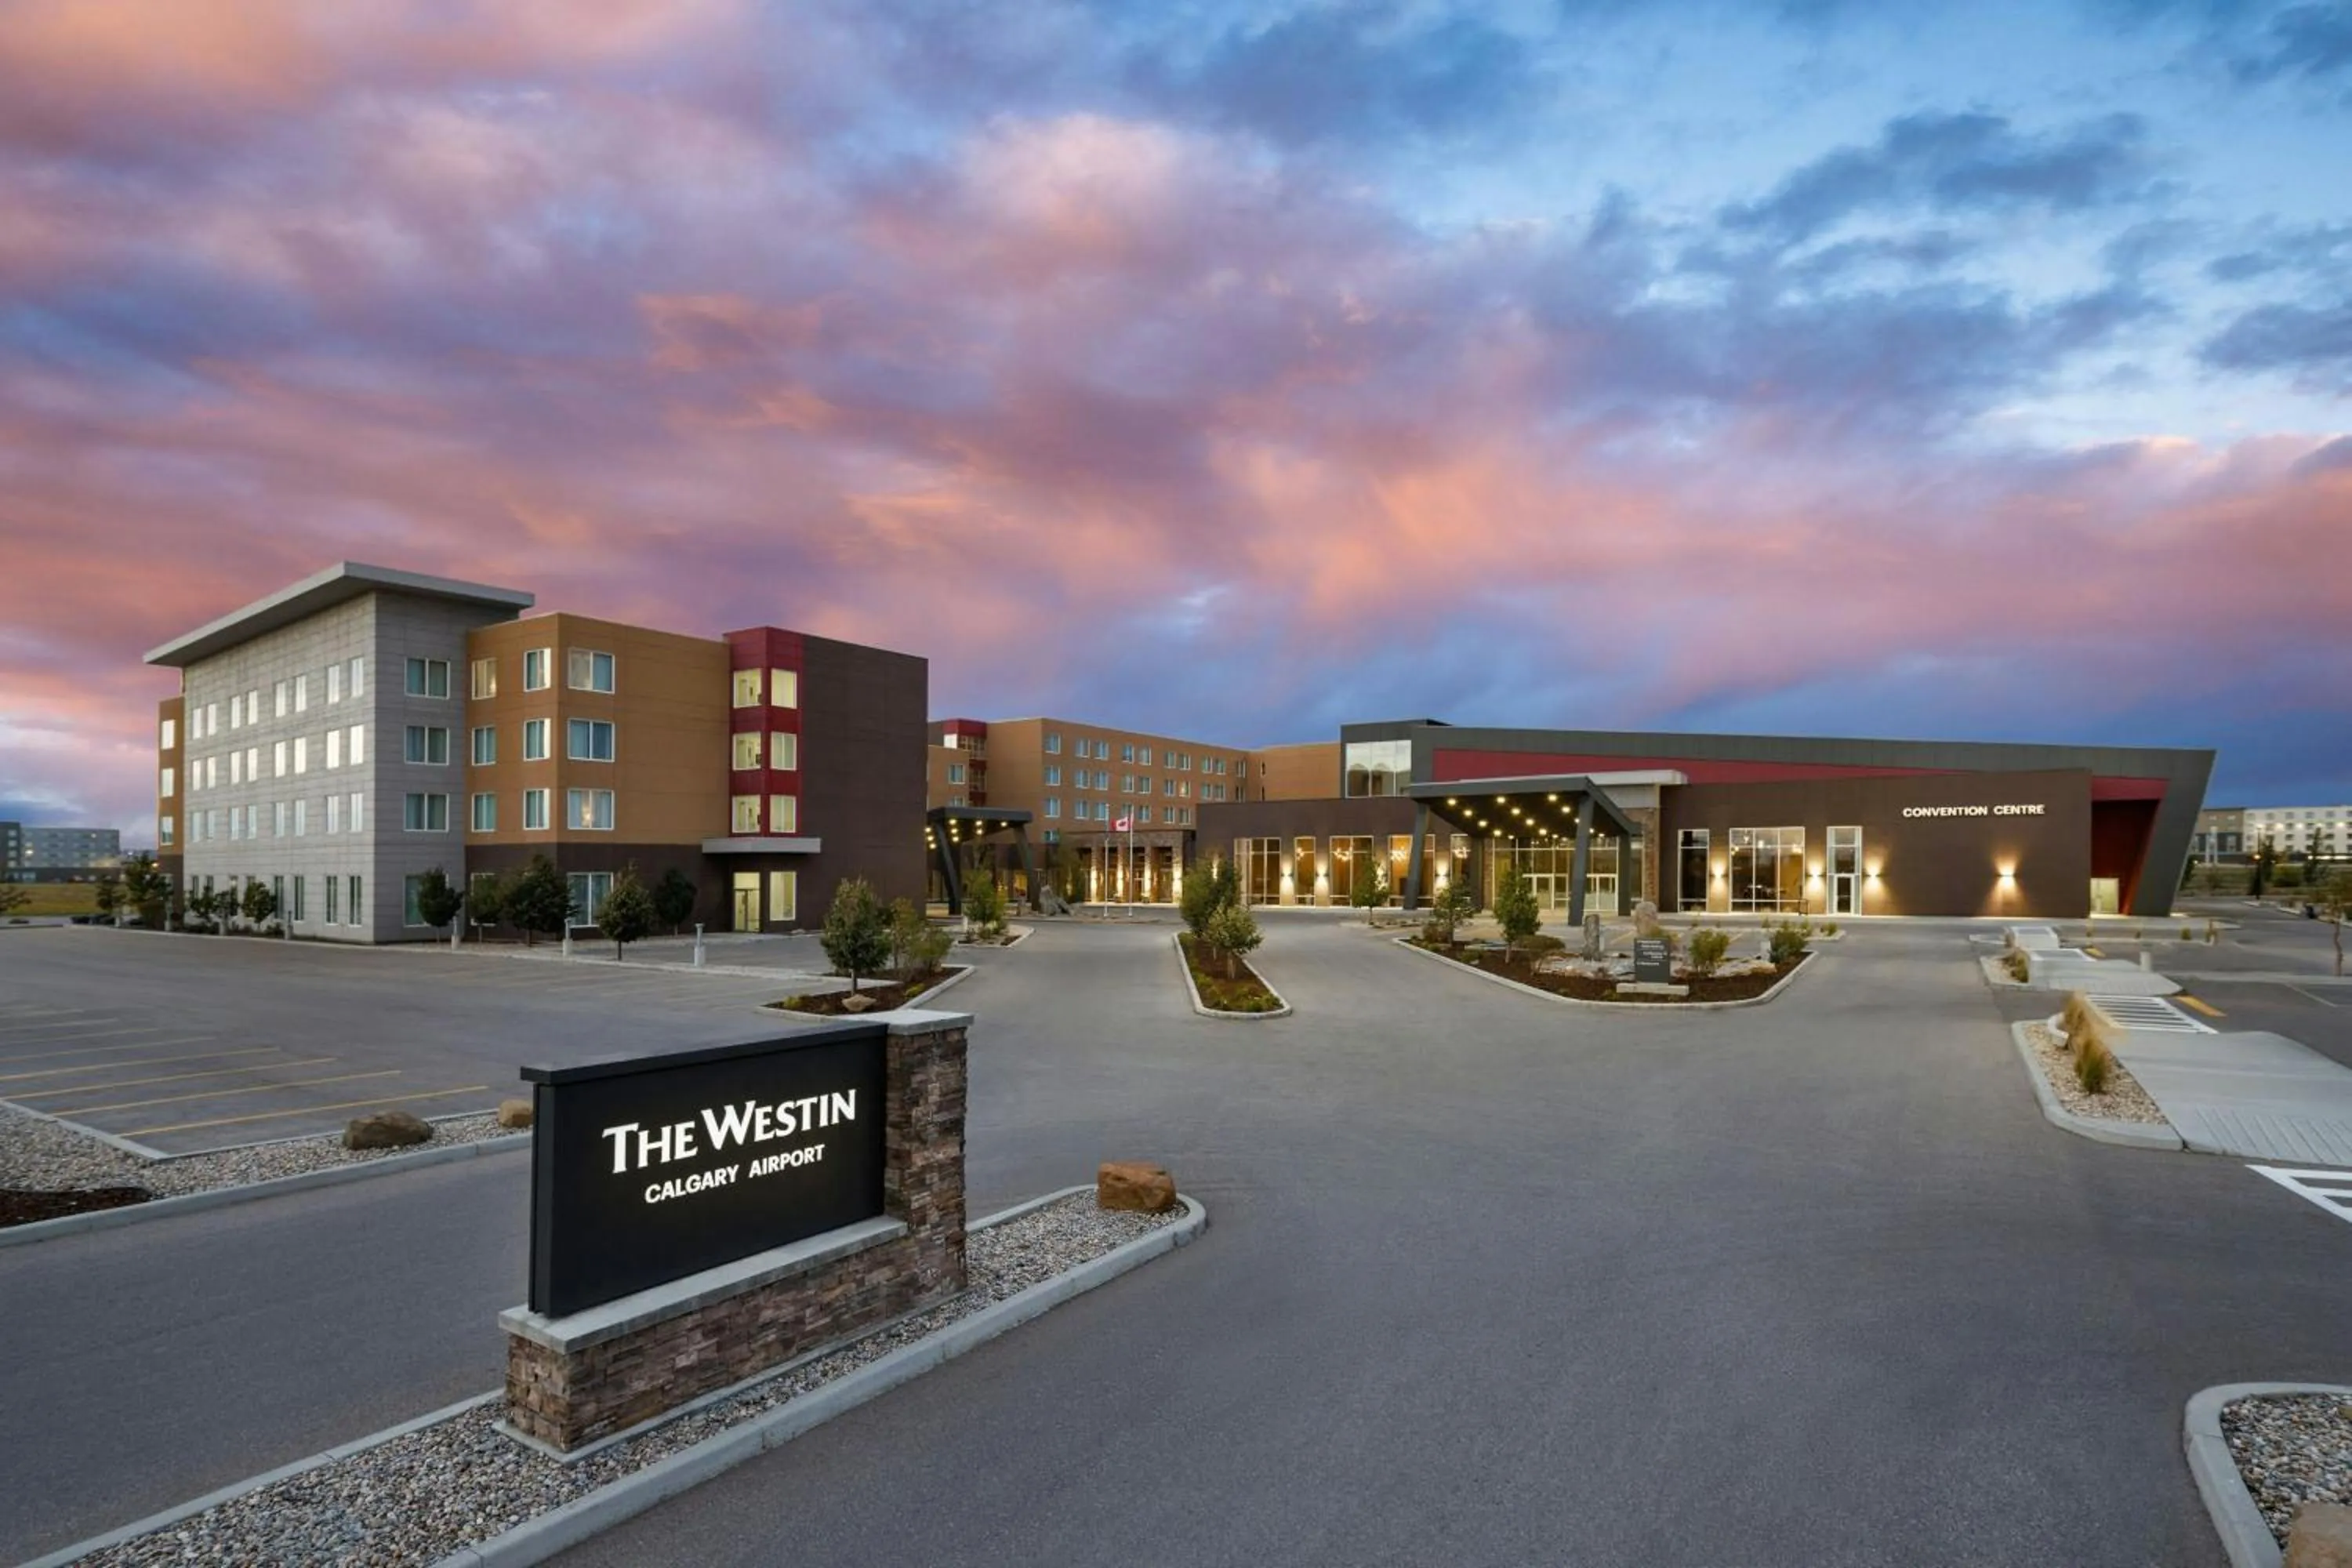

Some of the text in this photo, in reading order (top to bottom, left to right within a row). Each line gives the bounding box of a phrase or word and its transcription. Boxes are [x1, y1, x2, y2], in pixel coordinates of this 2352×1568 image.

[1902, 804, 2045, 818] CONVENTION CENTRE
[601, 1088, 857, 1174] THE WESTIN
[644, 1144, 826, 1203] CALGARY AIRPORT
